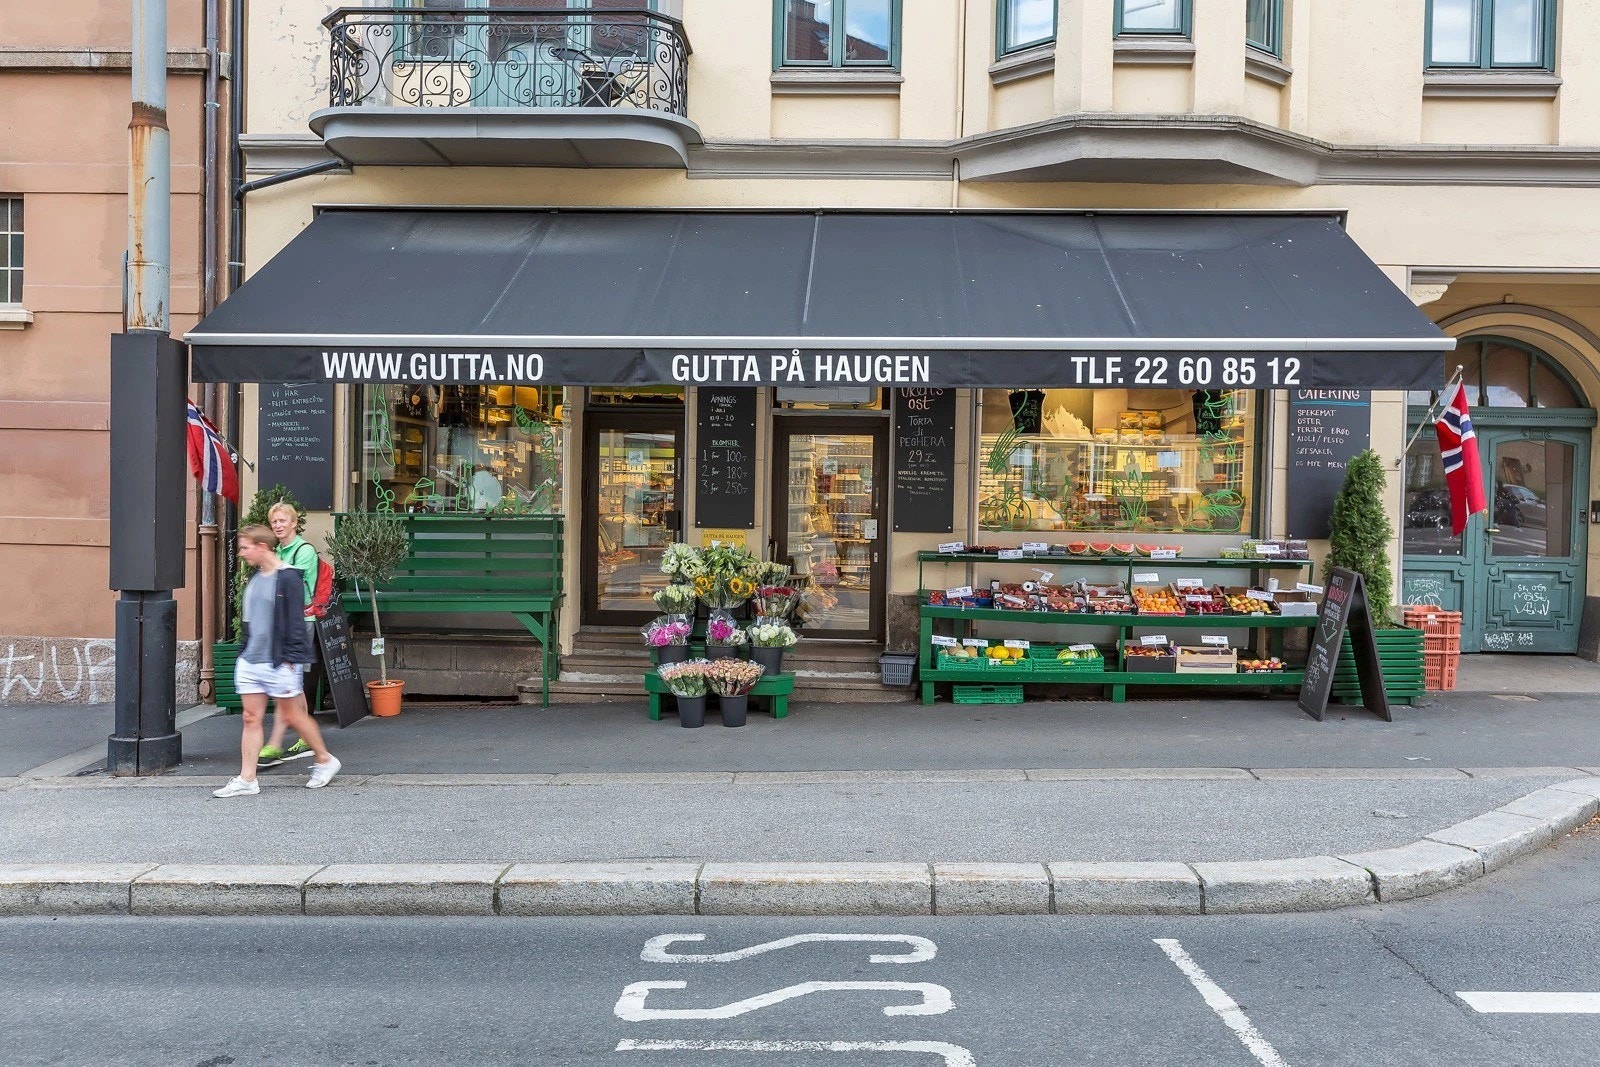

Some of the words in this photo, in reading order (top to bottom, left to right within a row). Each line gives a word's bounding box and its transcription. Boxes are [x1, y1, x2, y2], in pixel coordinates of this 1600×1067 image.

[322, 352, 544, 380] WWW.GUTTA.NO
[671, 354, 761, 382] GUTTA
[771, 349, 805, 382] PÅ
[815, 355, 930, 382] HAUGEN
[1070, 356, 1124, 384] TLF.
[1134, 356, 1168, 384] 22
[1178, 357, 1212, 384] 60
[1222, 357, 1256, 385] 85
[1267, 357, 1301, 385] 12
[1298, 389, 1360, 400] CATERING
[908, 395, 935, 410] ost
[1297, 409, 1337, 417] SPEKEMAT
[1297, 417, 1321, 425] OSTER
[900, 436, 946, 447] PEGHERA
[701, 464, 710, 476] 2
